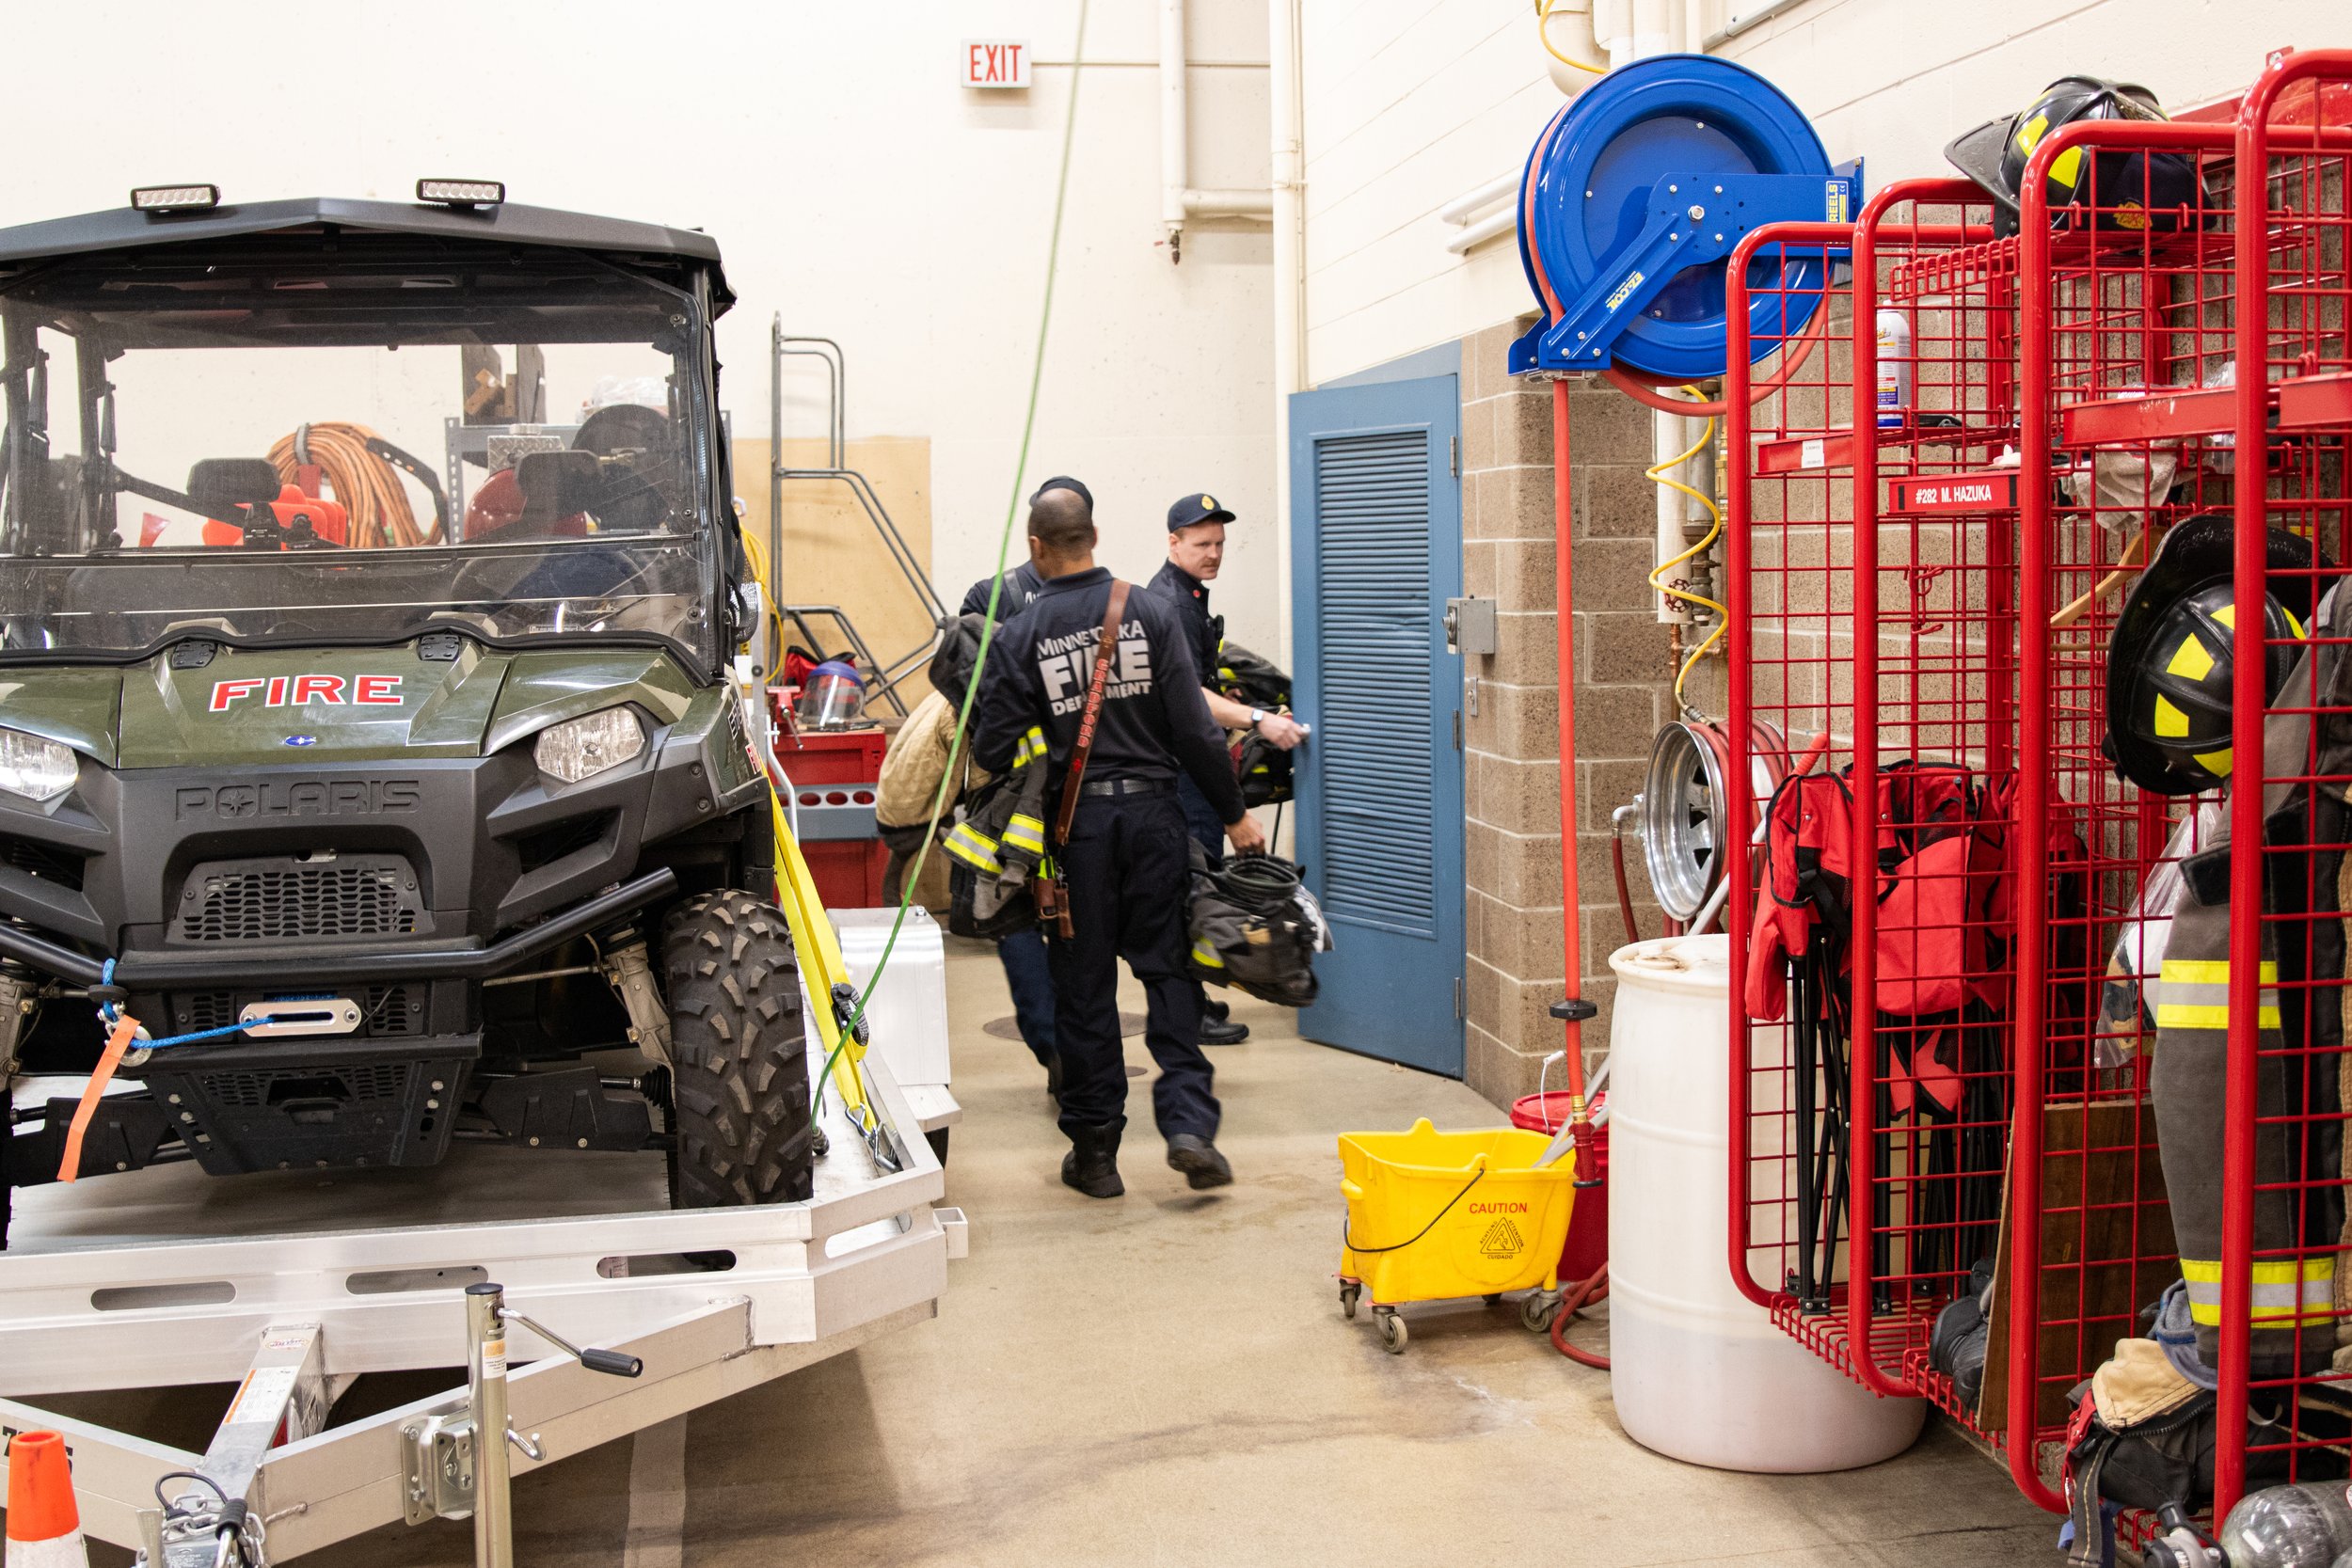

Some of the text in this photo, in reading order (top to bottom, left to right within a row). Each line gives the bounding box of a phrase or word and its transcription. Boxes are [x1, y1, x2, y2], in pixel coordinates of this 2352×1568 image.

[970, 44, 1022, 82] EXIT
[1915, 484, 1993, 504] #282 M. HAZUKA
[1037, 620, 1147, 659] MINNEOKA
[1039, 640, 1152, 702] FIRE
[209, 674, 404, 712] FIRE
[1050, 681, 1152, 716] DEPMENT
[175, 780, 420, 821] POLARIS
[1469, 1202, 1528, 1214] CAUTION
[1480, 1220, 1499, 1244] ACHTUNG
[1508, 1219, 1524, 1248] ATTENTION
